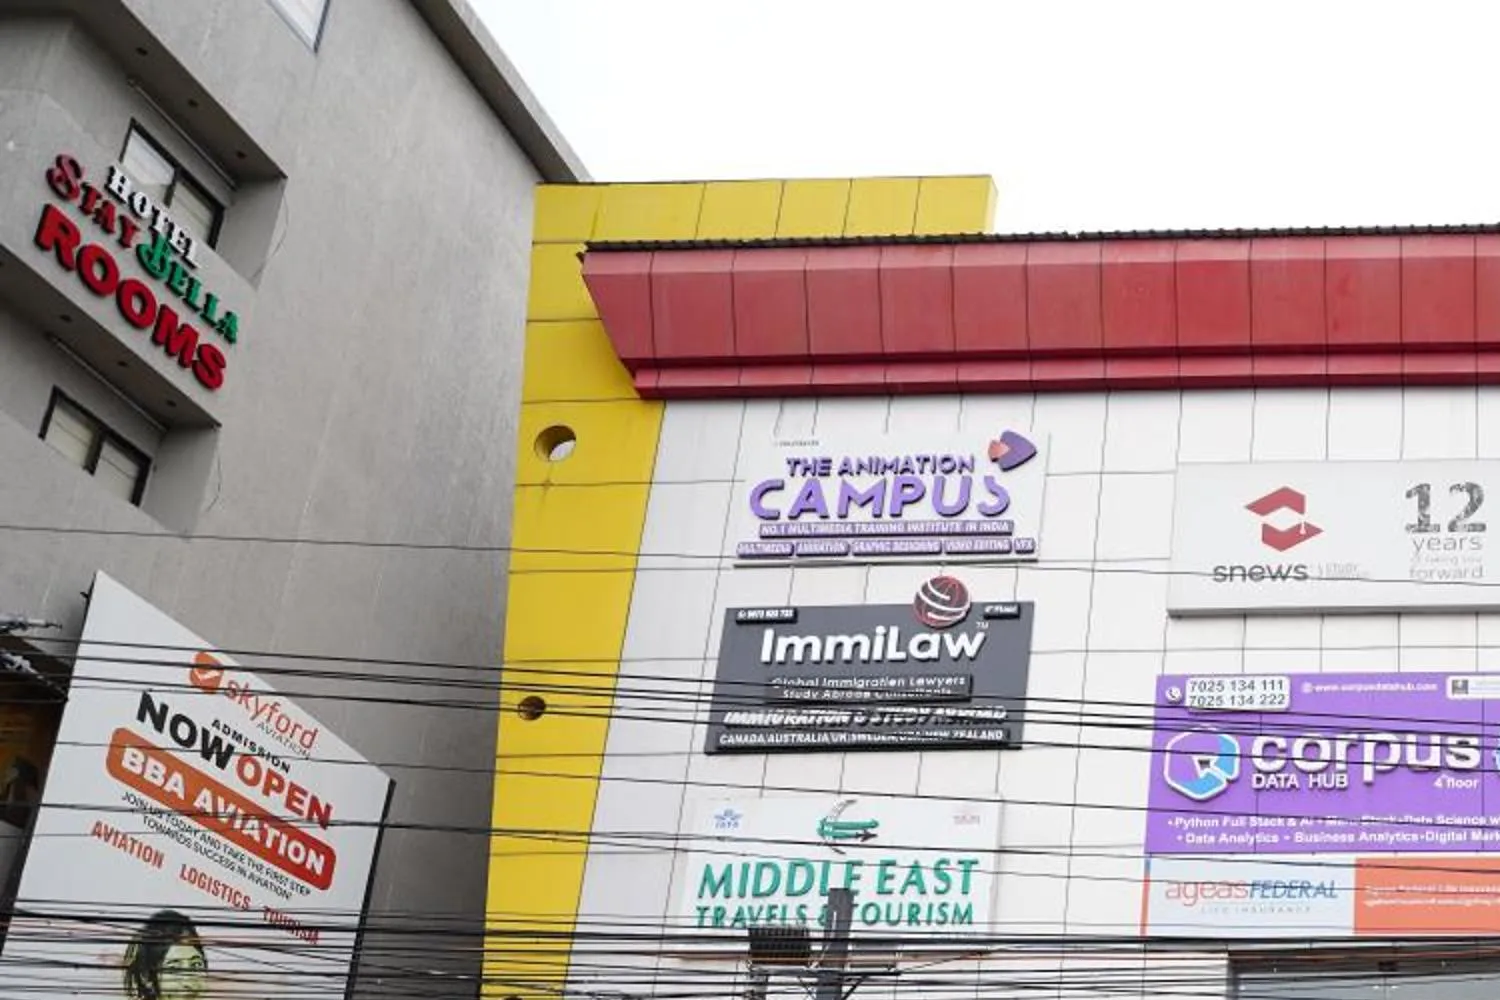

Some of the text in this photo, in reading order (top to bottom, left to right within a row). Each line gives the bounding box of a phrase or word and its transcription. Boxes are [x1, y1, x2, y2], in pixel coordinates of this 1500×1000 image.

[45, 154, 141, 248] STAY
[104, 164, 201, 269] HOTEL
[33, 203, 227, 391] ROOMS
[786, 455, 975, 477] THE ANIMATION
[750, 474, 1012, 521] CAMPUS
[1404, 481, 1488, 533] 12
[790, 523, 851, 535] MULTIMEDIA
[854, 522, 905, 534] TRAINING
[907, 521, 961, 533] INSTITUTE
[980, 520, 1010, 532] INDIA
[1412, 533, 1483, 555] years
[1212, 563, 1310, 584] snews
[1409, 566, 1483, 580] forward
[760, 625, 986, 663] ImmiLaw
[783, 688, 818, 700] Study
[822, 675, 905, 688] Immigration
[909, 674, 966, 688] Lawyers
[1188, 679, 1285, 693] 7025 134 111
[223, 676, 321, 753] skyford
[1188, 692, 1286, 707] 7025 134 222
[135, 689, 334, 830] NOW OPEN
[210, 717, 292, 774] ADMISSION
[1251, 730, 1482, 785] corpus
[1252, 773, 1349, 790] DATA HUB
[120, 744, 326, 877] BBA AVIATION
[164, 810, 200, 838] TODAY
[1222, 815, 1247, 828] Full
[1249, 815, 1285, 829] Stack
[1435, 814, 1486, 826] Science
[142, 816, 236, 874] TOWARDS SUCCESS
[1185, 831, 1215, 844] Data
[1218, 831, 1280, 846] Analytics
[1294, 831, 1355, 844] Business
[1358, 830, 1419, 846] Analytics
[1425, 830, 1468, 846] Digital
[91, 819, 166, 870] AVIATION
[179, 862, 253, 912] LOGISTICS
[697, 857, 980, 900] MIDDLE EAST
[696, 903, 810, 930] TRAVELS
